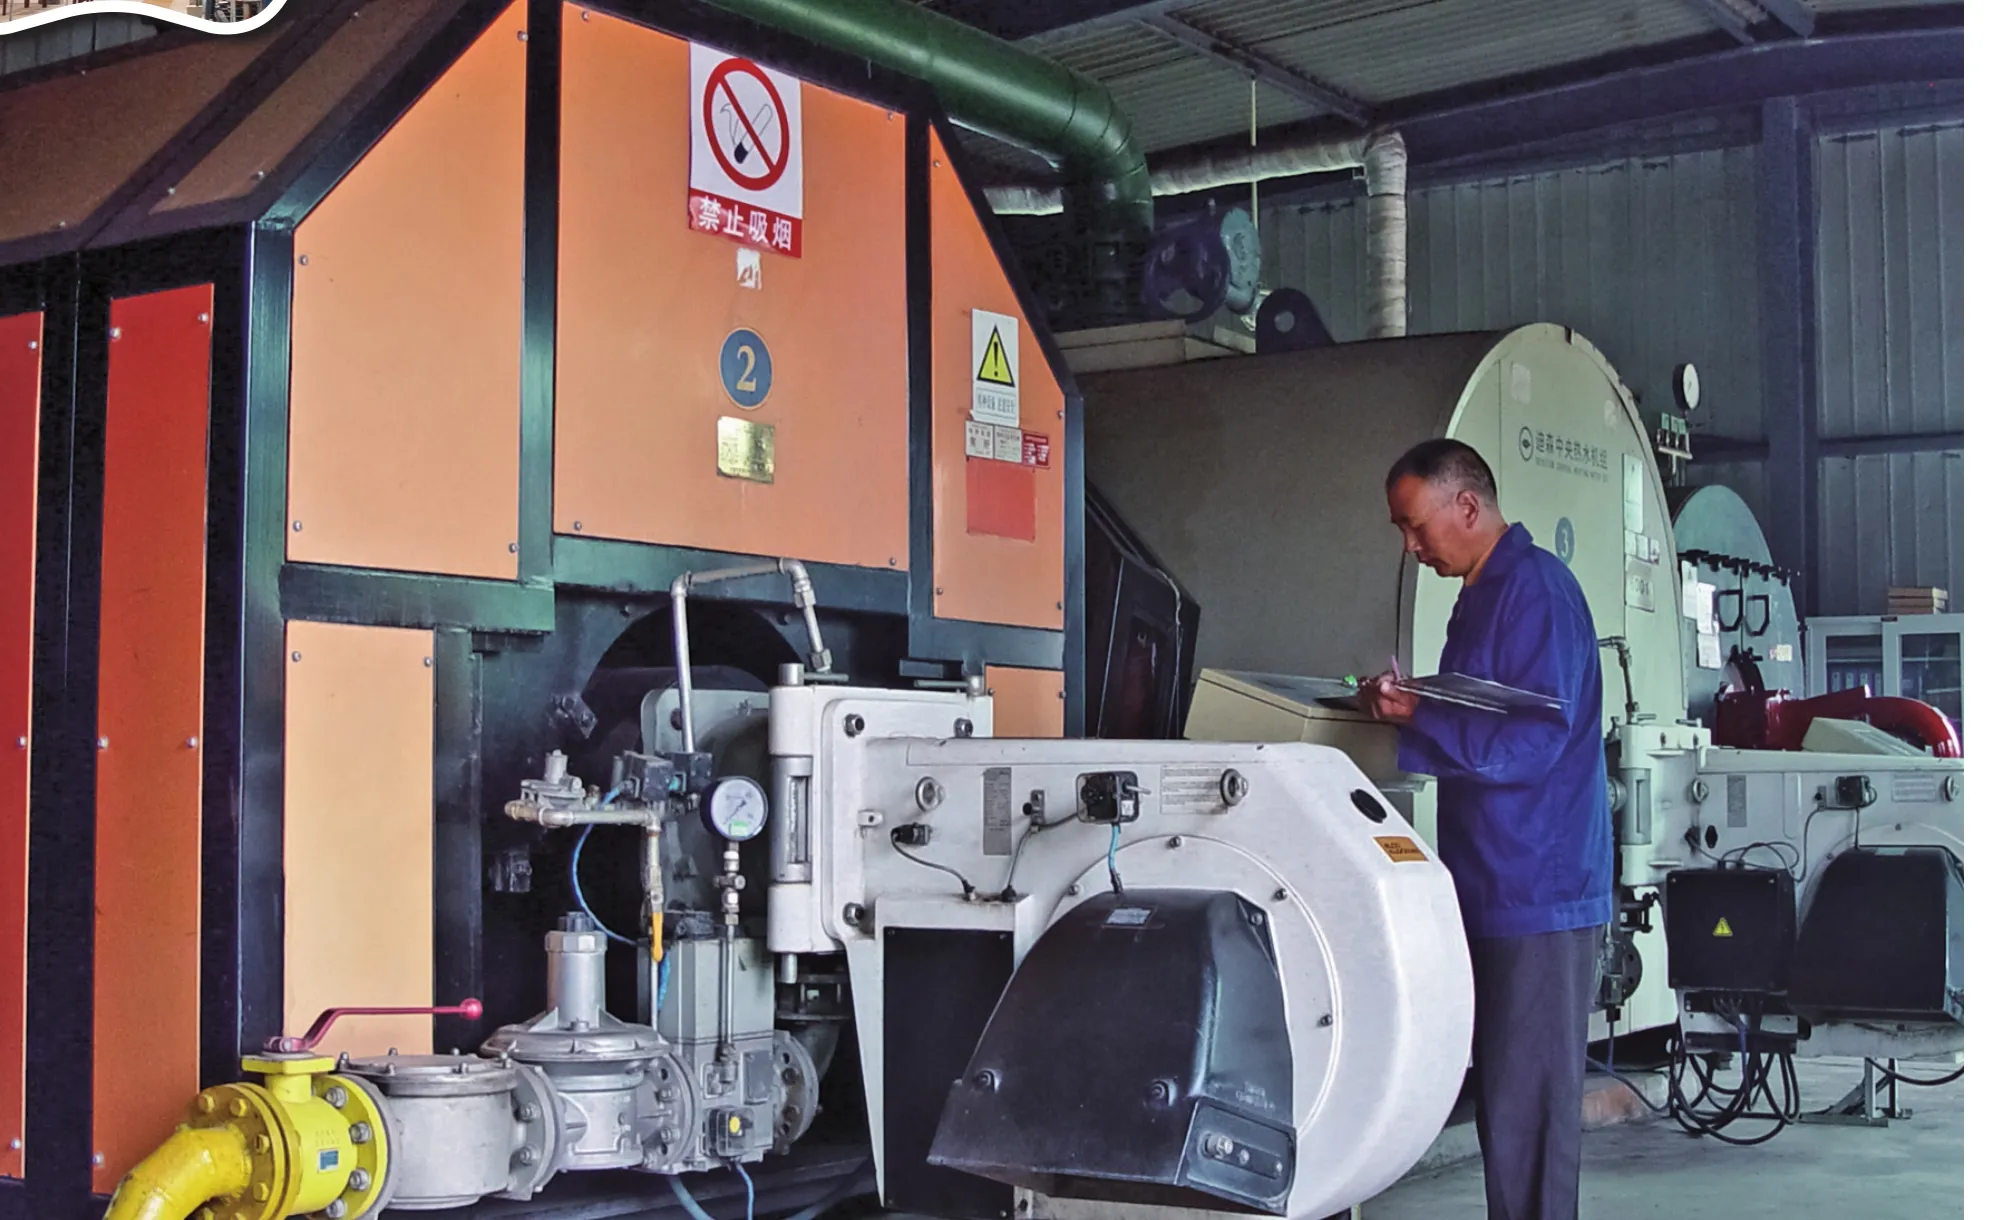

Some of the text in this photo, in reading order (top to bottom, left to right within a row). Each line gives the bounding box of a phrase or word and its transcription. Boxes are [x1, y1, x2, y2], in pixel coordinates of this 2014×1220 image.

[699, 195, 792, 251] 禁止吸烟
[736, 345, 757, 392] 2
[1561, 529, 1569, 558] 3
